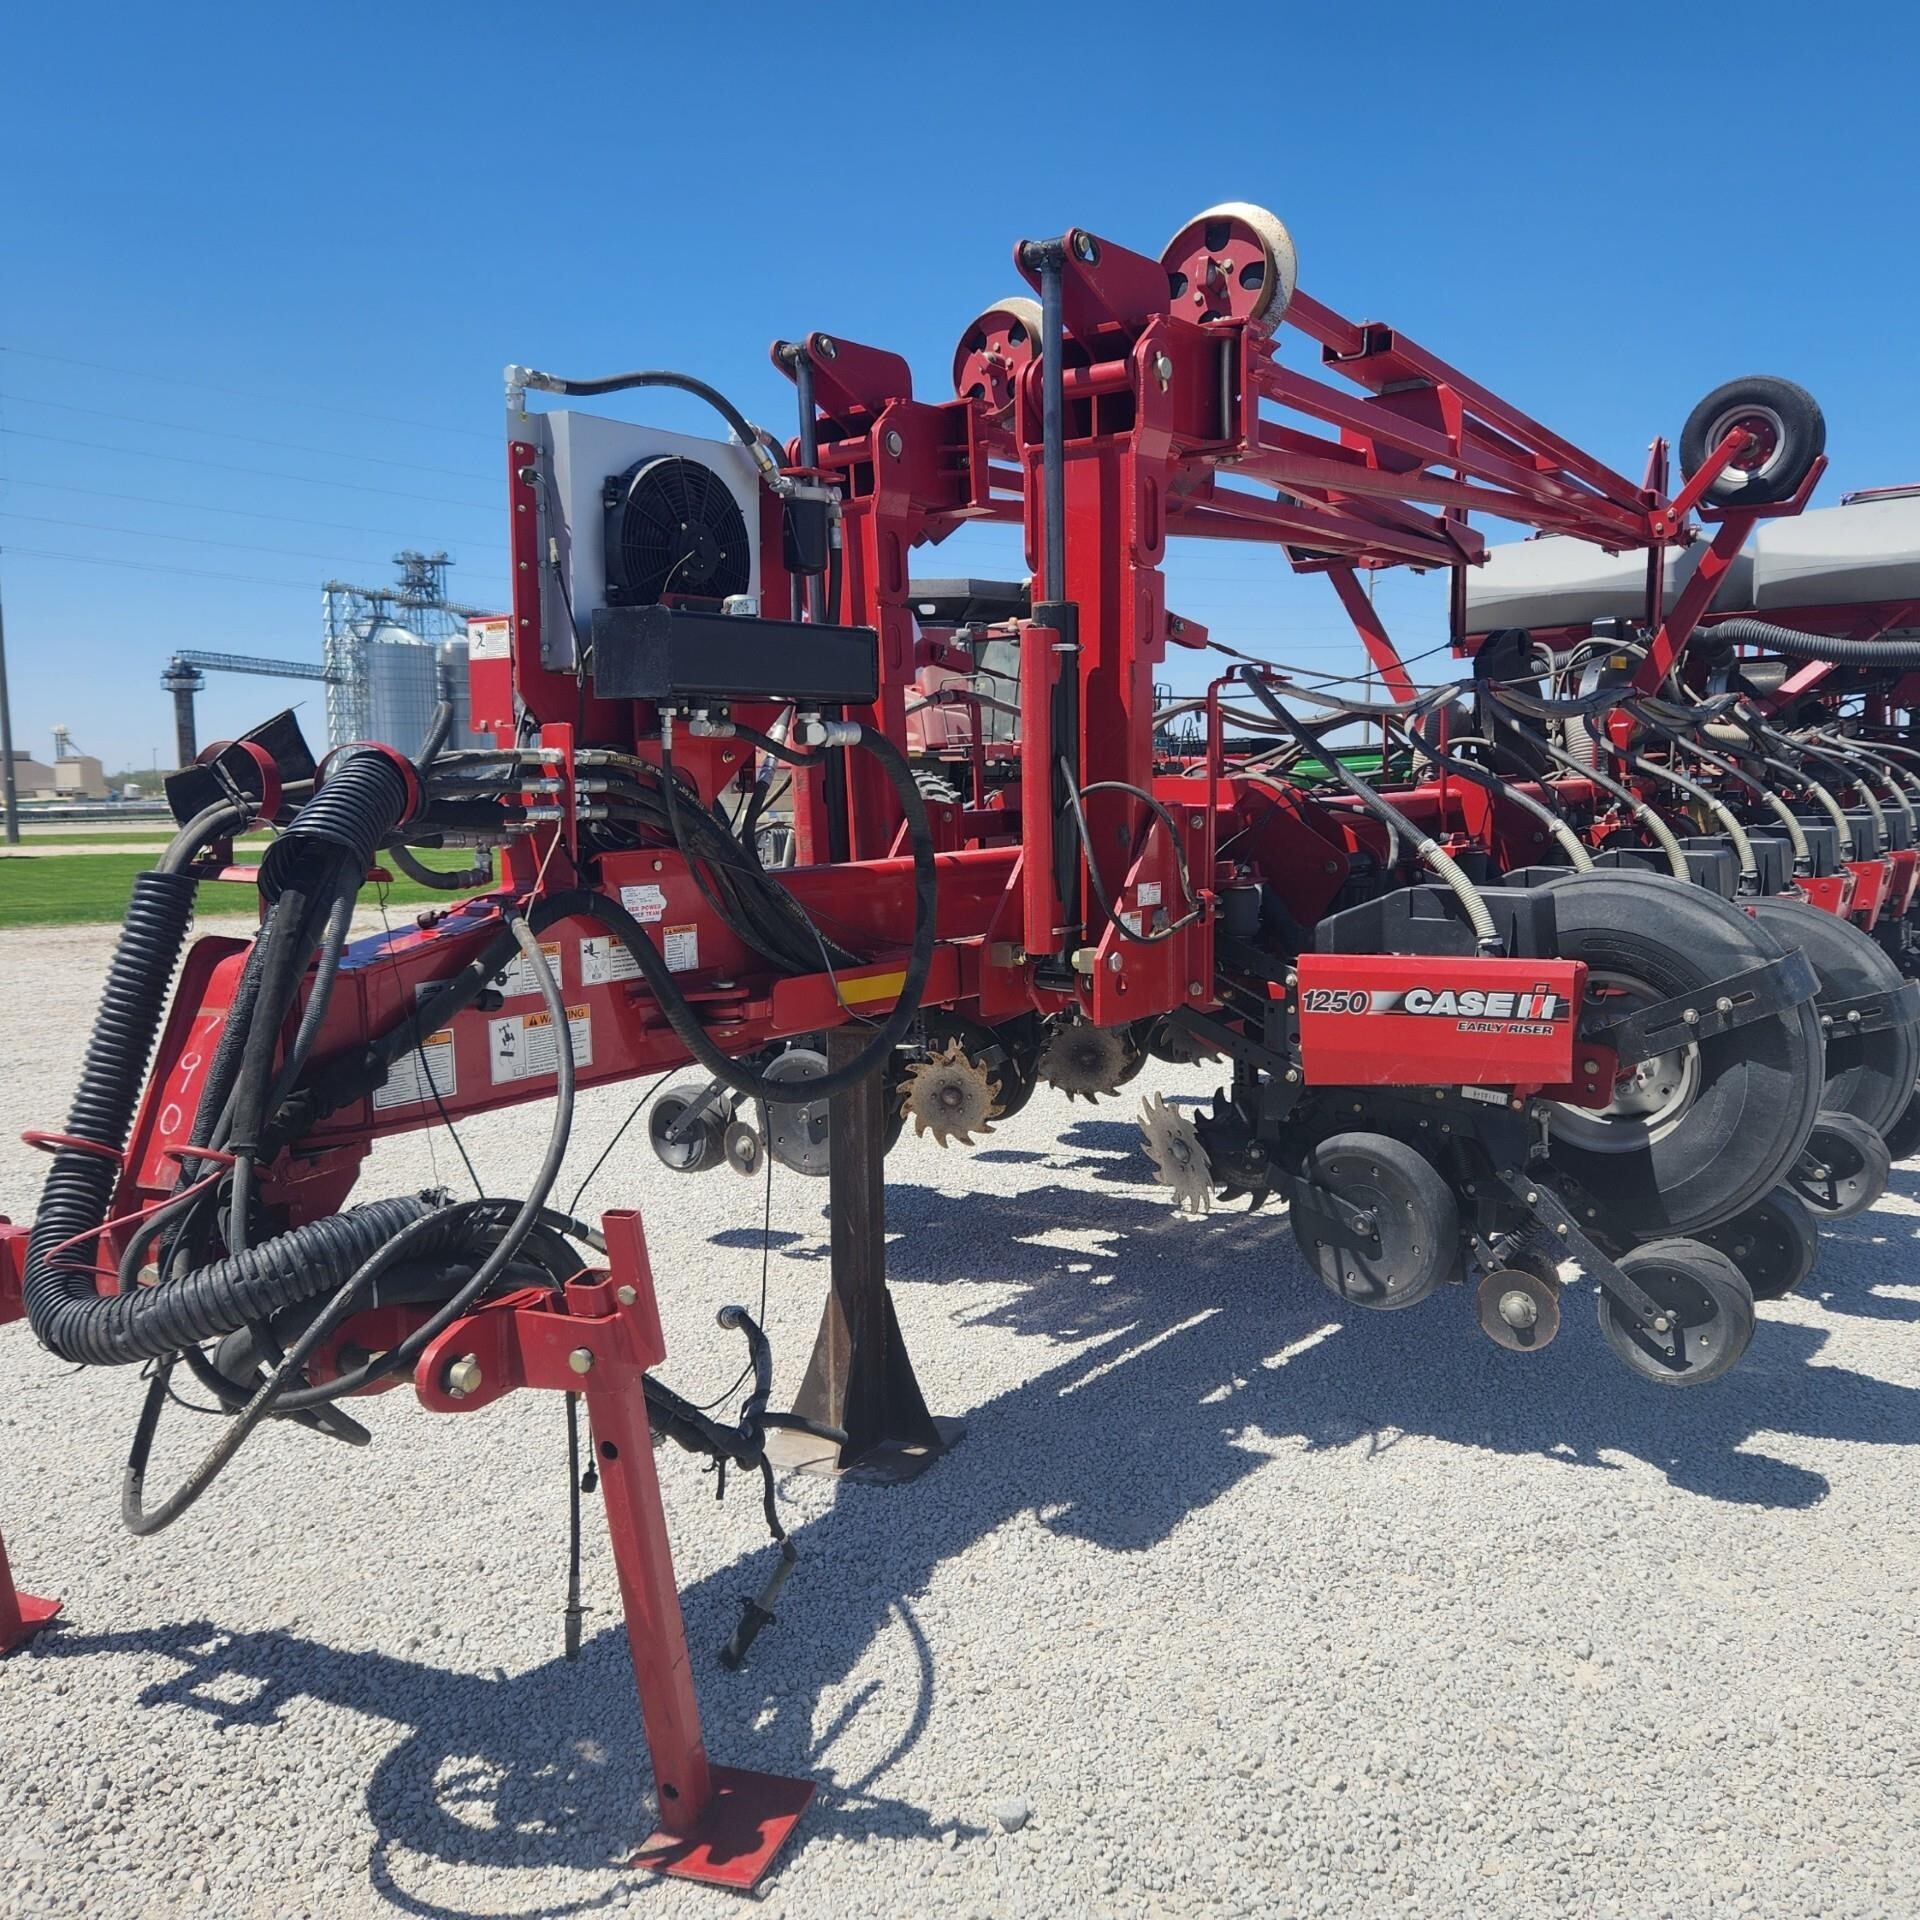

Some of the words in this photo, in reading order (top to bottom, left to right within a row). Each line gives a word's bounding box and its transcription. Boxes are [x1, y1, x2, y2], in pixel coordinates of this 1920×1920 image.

[1302, 989, 1369, 1014] 1250
[1404, 989, 1515, 1017] CASE
[540, 1009, 584, 1023] WING
[1457, 1021, 1504, 1032] EARLY
[1507, 1024, 1553, 1036] RISER
